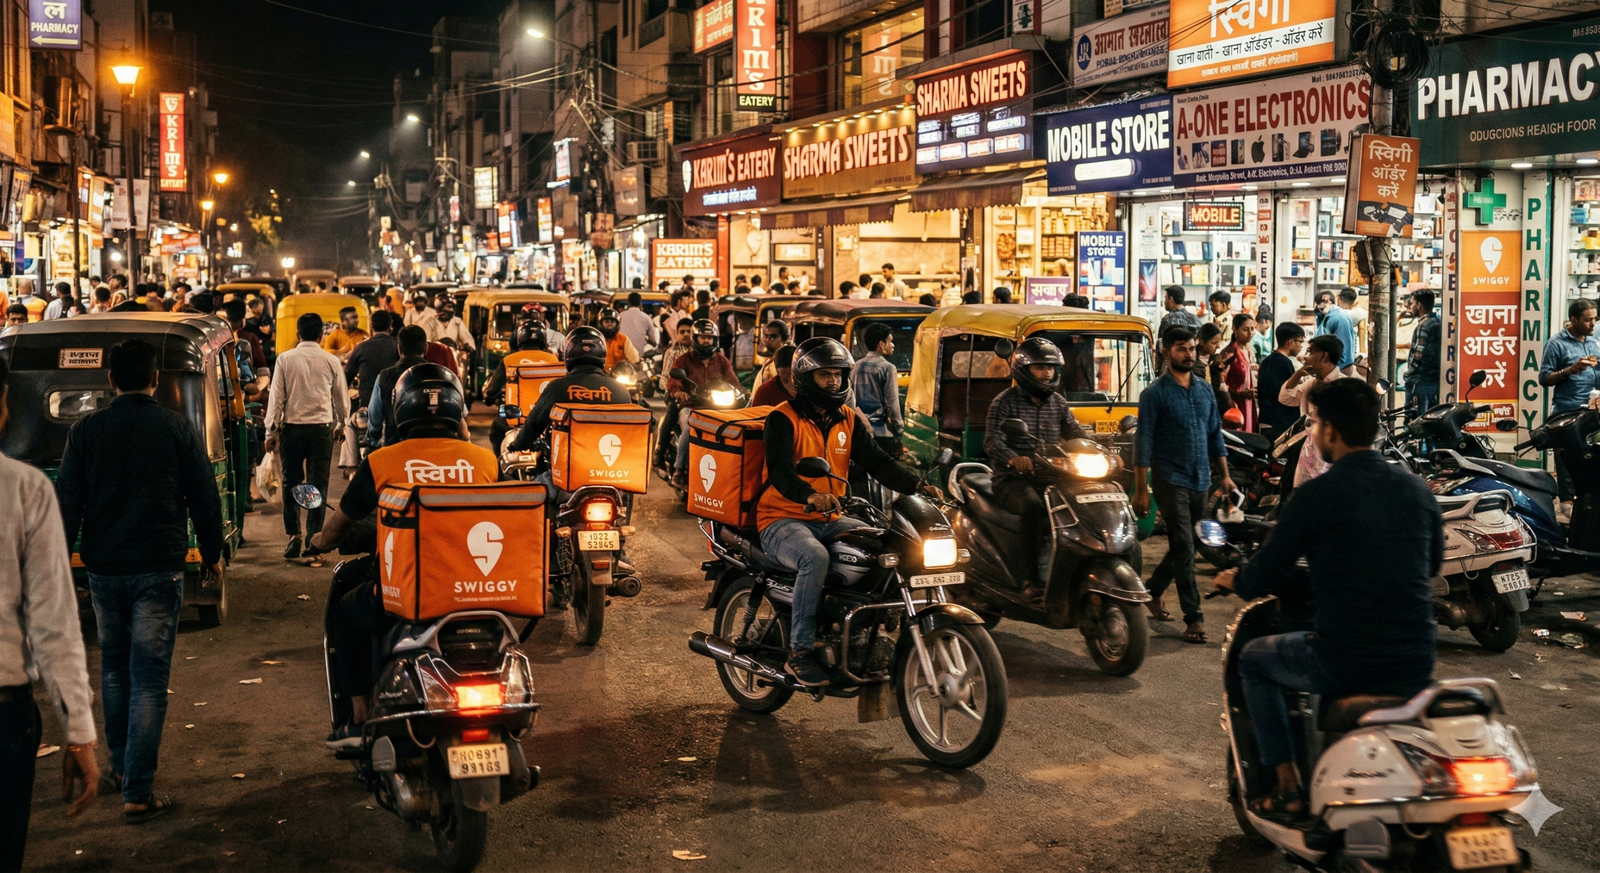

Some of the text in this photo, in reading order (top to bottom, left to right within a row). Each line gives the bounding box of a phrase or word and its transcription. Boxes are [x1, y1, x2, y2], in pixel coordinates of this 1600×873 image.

[31, 22, 79, 34] PHARMACY
[1176, 52, 1195, 65] खाना
[1222, 43, 1242, 57] खाना
[1308, 23, 1324, 40] करें
[917, 75, 968, 116] SHARMA
[970, 60, 1026, 106] SWEETS
[1417, 50, 1600, 120] PHARMAC
[739, 95, 774, 107] EATERY
[1177, 79, 1370, 140] A-ONE ELECTRONICS
[1047, 121, 1107, 163] MOBILE
[1111, 111, 1170, 155] STORE
[784, 138, 840, 180] SHARMA
[844, 125, 909, 170] SWEETS
[1369, 140, 1413, 163] स्विगी
[694, 147, 776, 189] KARIM'S EATERY
[1372, 164, 1407, 181] ऑर्डर
[1378, 182, 1399, 198] करें
[1192, 207, 1241, 223] MOBILE
[1080, 235, 1124, 247] MOBILE
[1087, 247, 1117, 256] STORE
[656, 256, 713, 268] EATERY
[1473, 276, 1510, 285] SWIGGY
[1465, 305, 1517, 325] खाना
[1522, 198, 1541, 430] PHARMACY
[1463, 328, 1517, 356] ऑर्डर
[567, 384, 612, 401] स्विगी
[404, 459, 475, 484] स्विगी
[589, 469, 630, 478] SWIGGY
[694, 493, 724, 509] SWIGGY
[454, 580, 518, 594] SWIGGY
